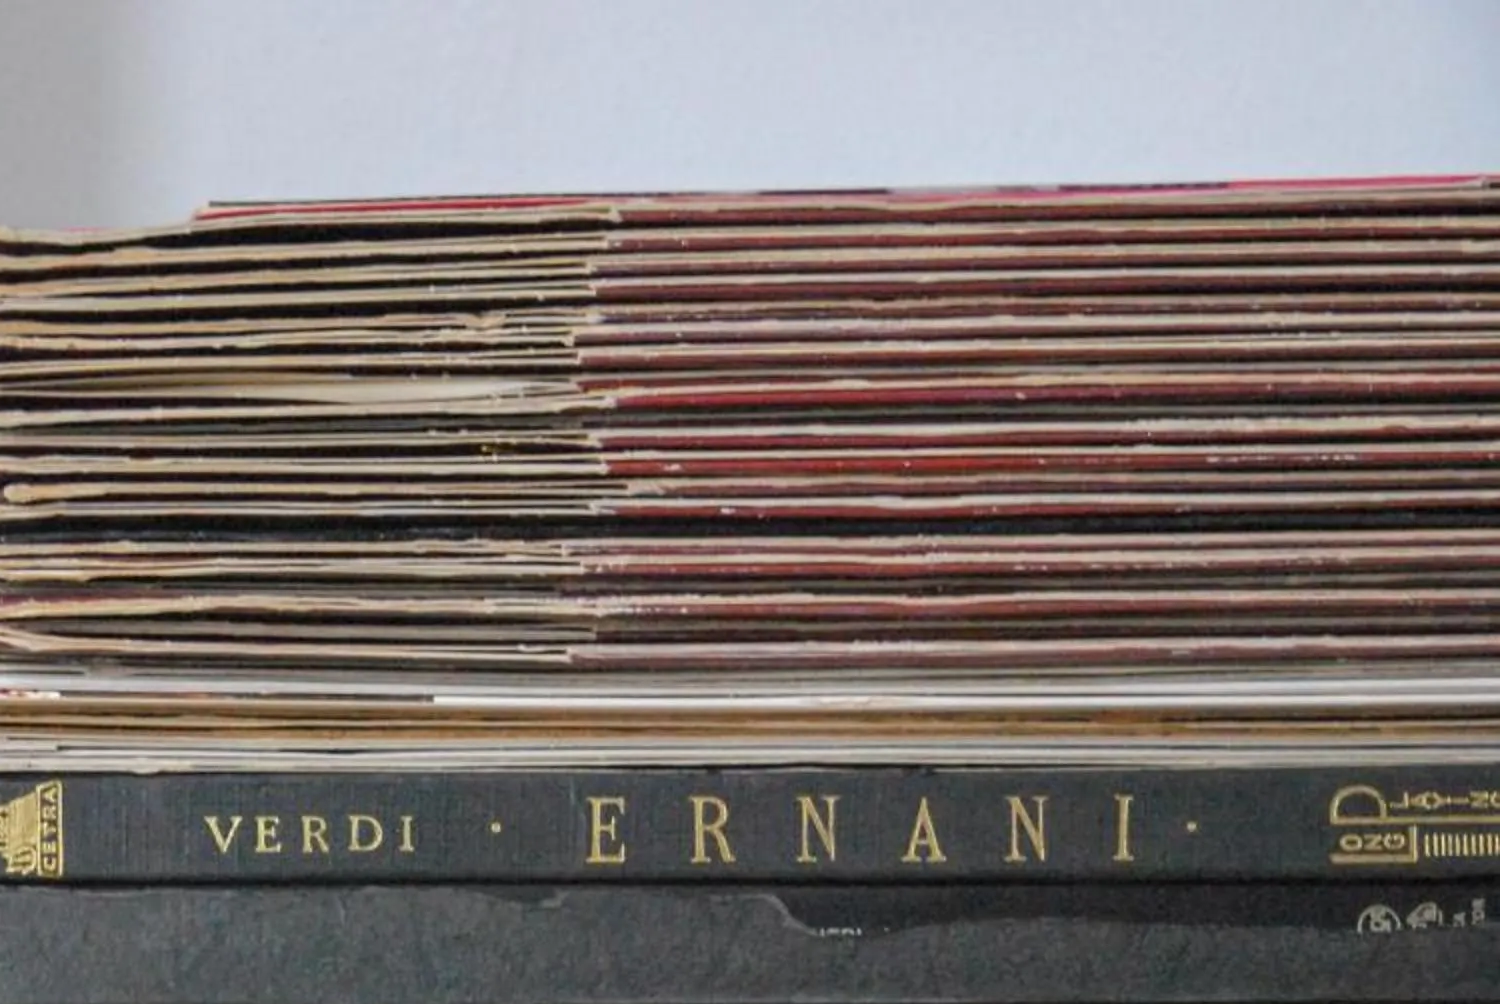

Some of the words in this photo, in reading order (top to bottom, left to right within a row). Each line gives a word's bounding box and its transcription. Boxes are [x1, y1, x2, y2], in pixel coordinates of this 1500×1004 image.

[40, 784, 62, 871] CETRA
[204, 814, 417, 854] VERDI
[585, 795, 1134, 865] ERNANI
